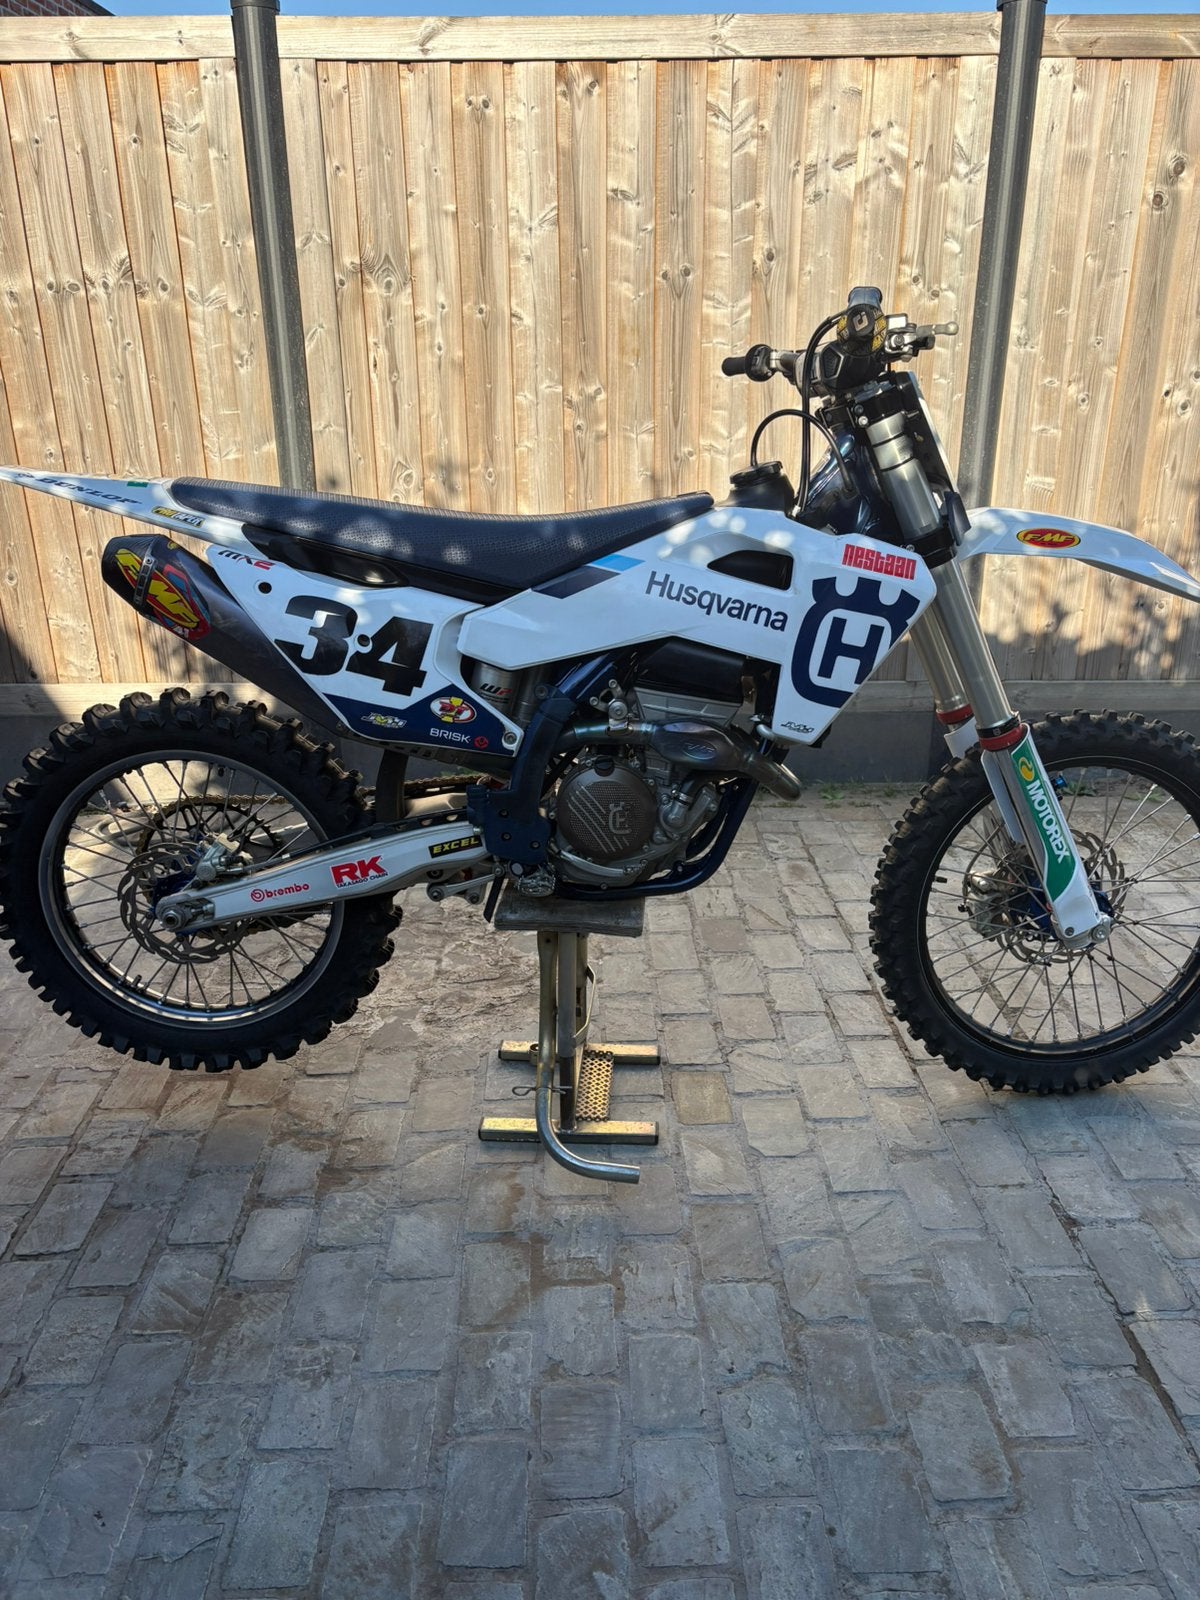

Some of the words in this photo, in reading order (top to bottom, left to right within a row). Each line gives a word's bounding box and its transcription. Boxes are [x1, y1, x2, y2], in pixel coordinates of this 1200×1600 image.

[35, 478, 143, 504] DUNLOP
[218, 550, 276, 570] MX2
[645, 570, 789, 632] Husqvarna
[273, 595, 434, 697] 34
[429, 727, 471, 744] BRISK
[1026, 778, 1071, 864] MOTOREX
[432, 836, 480, 854] EXCEL
[331, 855, 387, 885] RK
[265, 882, 310, 899] brembo
